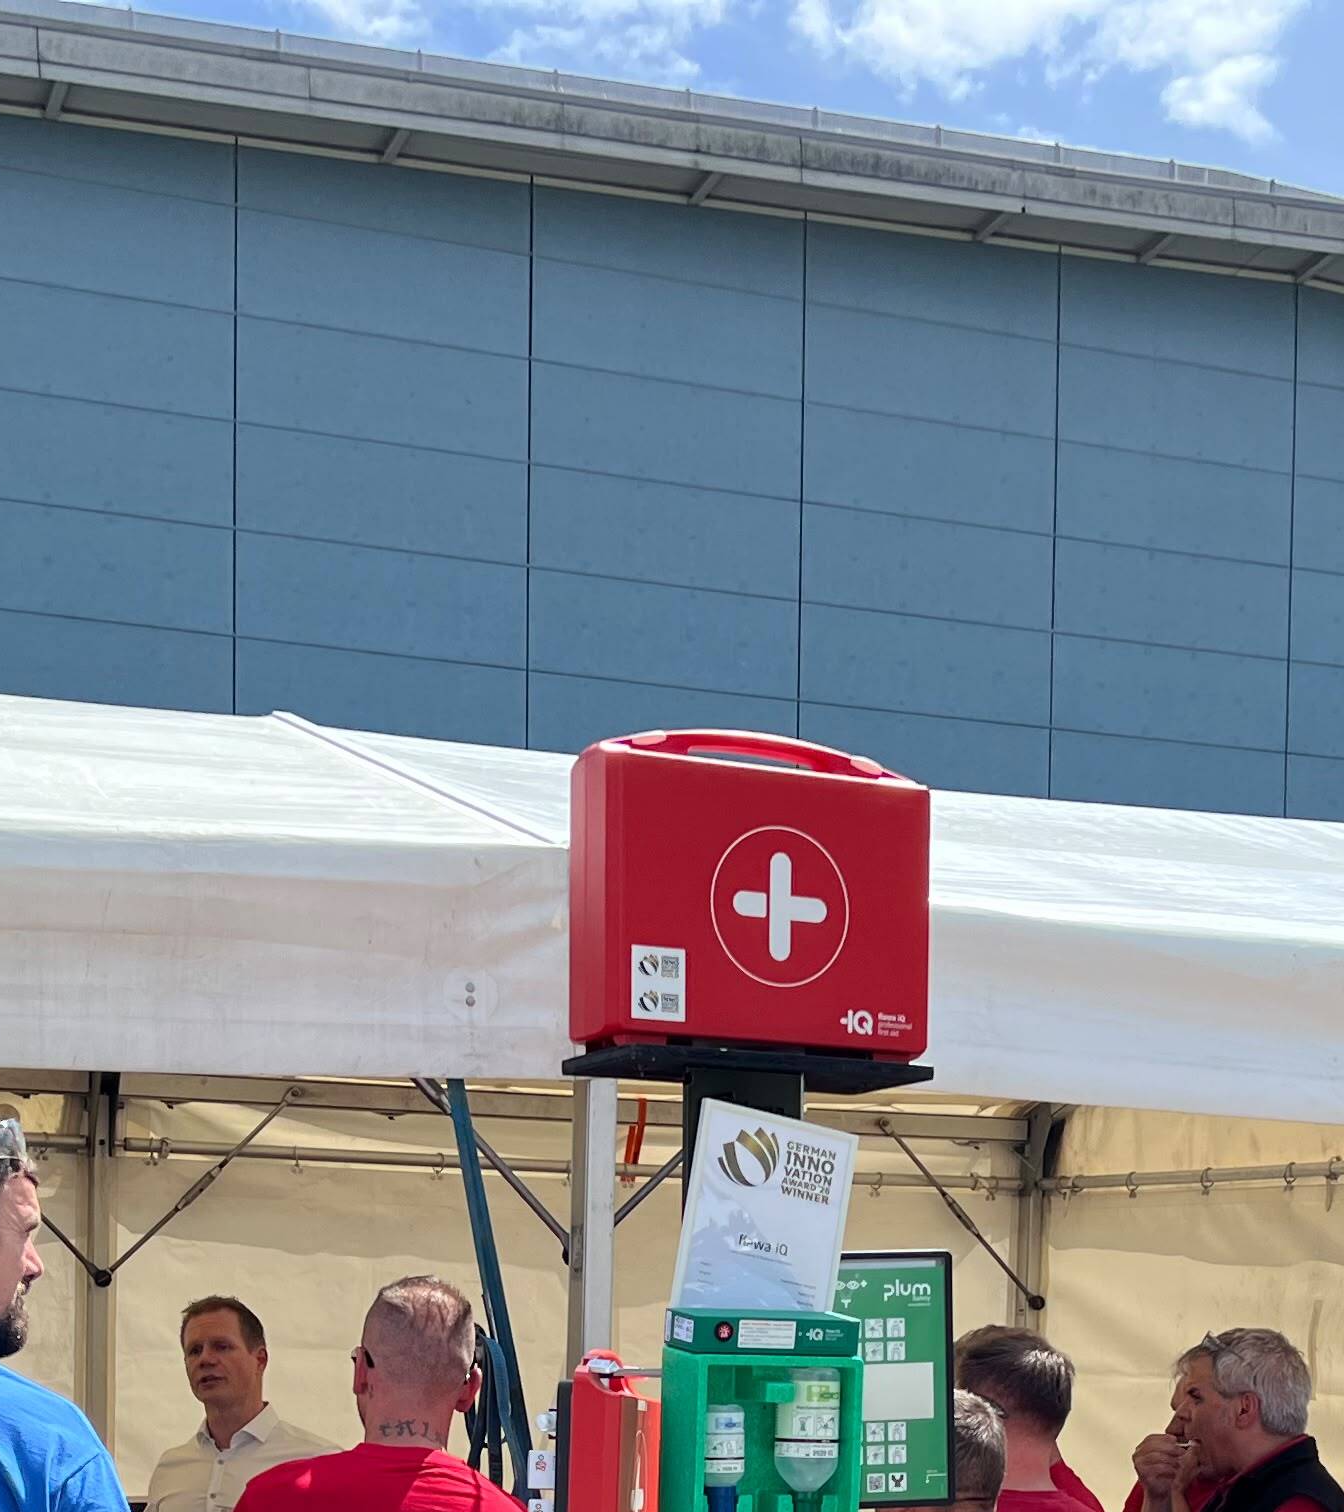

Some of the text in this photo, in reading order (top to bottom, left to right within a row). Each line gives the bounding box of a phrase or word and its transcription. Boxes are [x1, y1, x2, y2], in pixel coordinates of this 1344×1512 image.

[787, 1141, 836, 1160] GERMAN
[786, 1150, 834, 1175] INNO
[782, 1178, 816, 1191] AWARD
[784, 1165, 832, 1187] VATION
[781, 1185, 829, 1205] WINNER
[883, 1279, 932, 1302] plum
